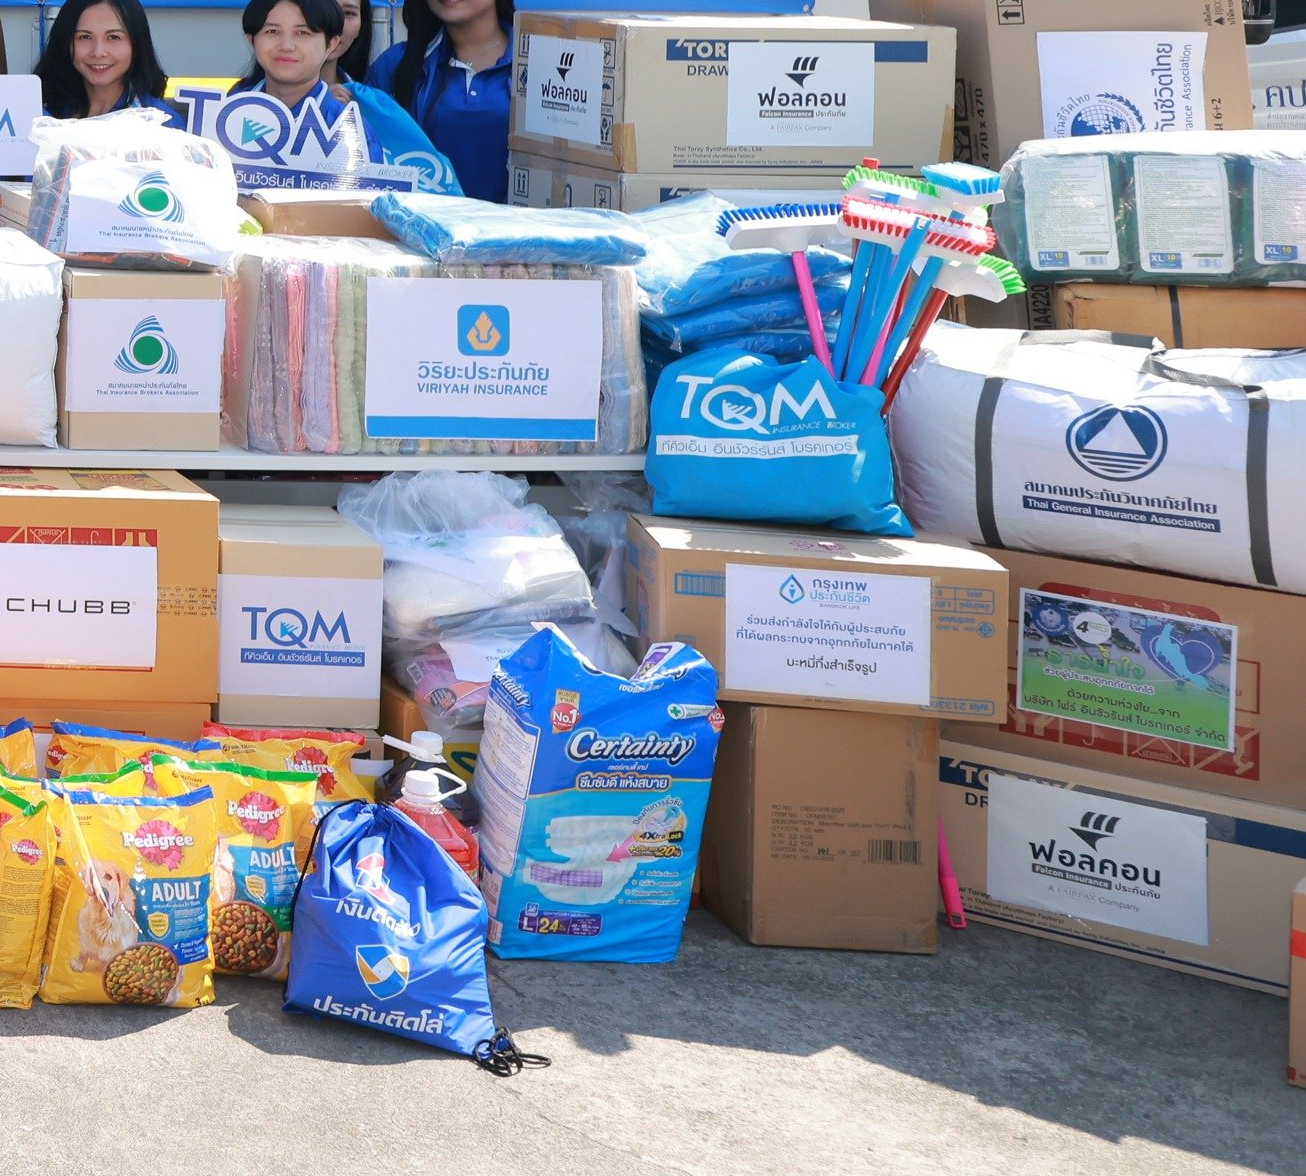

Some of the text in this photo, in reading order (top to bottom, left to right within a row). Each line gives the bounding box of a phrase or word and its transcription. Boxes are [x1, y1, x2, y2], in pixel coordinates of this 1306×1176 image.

[1179, 43, 1193, 101] Association
[540, 79, 588, 105] ฟอลคอน
[758, 87, 847, 108] ฟอลคอน
[760, 109, 847, 119] Falcon Insurance ประกันภัย
[178, 88, 385, 166] TQM
[805, 125, 833, 133] Company
[418, 360, 550, 382] วิริยะประกันภัย
[110, 388, 199, 396] Insurance Brokers Association
[417, 383, 549, 396] VIRIYAH INSURANCE
[676, 374, 837, 435] TQM
[660, 440, 709, 456] ทีคิวเอ็ม
[1023, 479, 1219, 516] สมาคมประกันวินาศภัยไทย
[1026, 498, 1216, 530] Thai General Insurance Association
[811, 577, 868, 594] กรุงเทพ
[6, 597, 131, 616] CHUBB
[808, 589, 871, 605] ประกันชีวิต
[241, 607, 352, 649] TQM
[746, 614, 907, 639] ร่วมส่งกำลังใจให้กับผู้ประสบภัย
[735, 627, 915, 656] ที่ได้ผลกระทบจากอุทกภัยในภาคใต้
[243, 651, 363, 666] ทีคิวเอ็ม อินชัวร์รันส์ โบรคเกอร์
[786, 653, 878, 676] บะหมี่กึ่งสำเร็จรูป
[1045, 645, 1146, 680] ธารน้ำใจ
[552, 708, 578, 724] No.1
[1023, 692, 1053, 707] บริษัท
[1194, 727, 1226, 743] จำกัด
[567, 730, 695, 763] Certainty
[580, 775, 669, 790] ซึมซับดี แห้งสบาย
[226, 800, 286, 821] Pedigree
[121, 830, 194, 850] Pedigree
[249, 848, 297, 869] ADULT
[1029, 837, 1162, 888] ฟอลคอน
[151, 879, 202, 901] ADULT
[1034, 864, 1163, 901] Falcon Insurance ประกันภัย
[1098, 896, 1141, 914] Company
[538, 918, 561, 934] 24
[313, 992, 445, 1036] ประกันติดโล่
